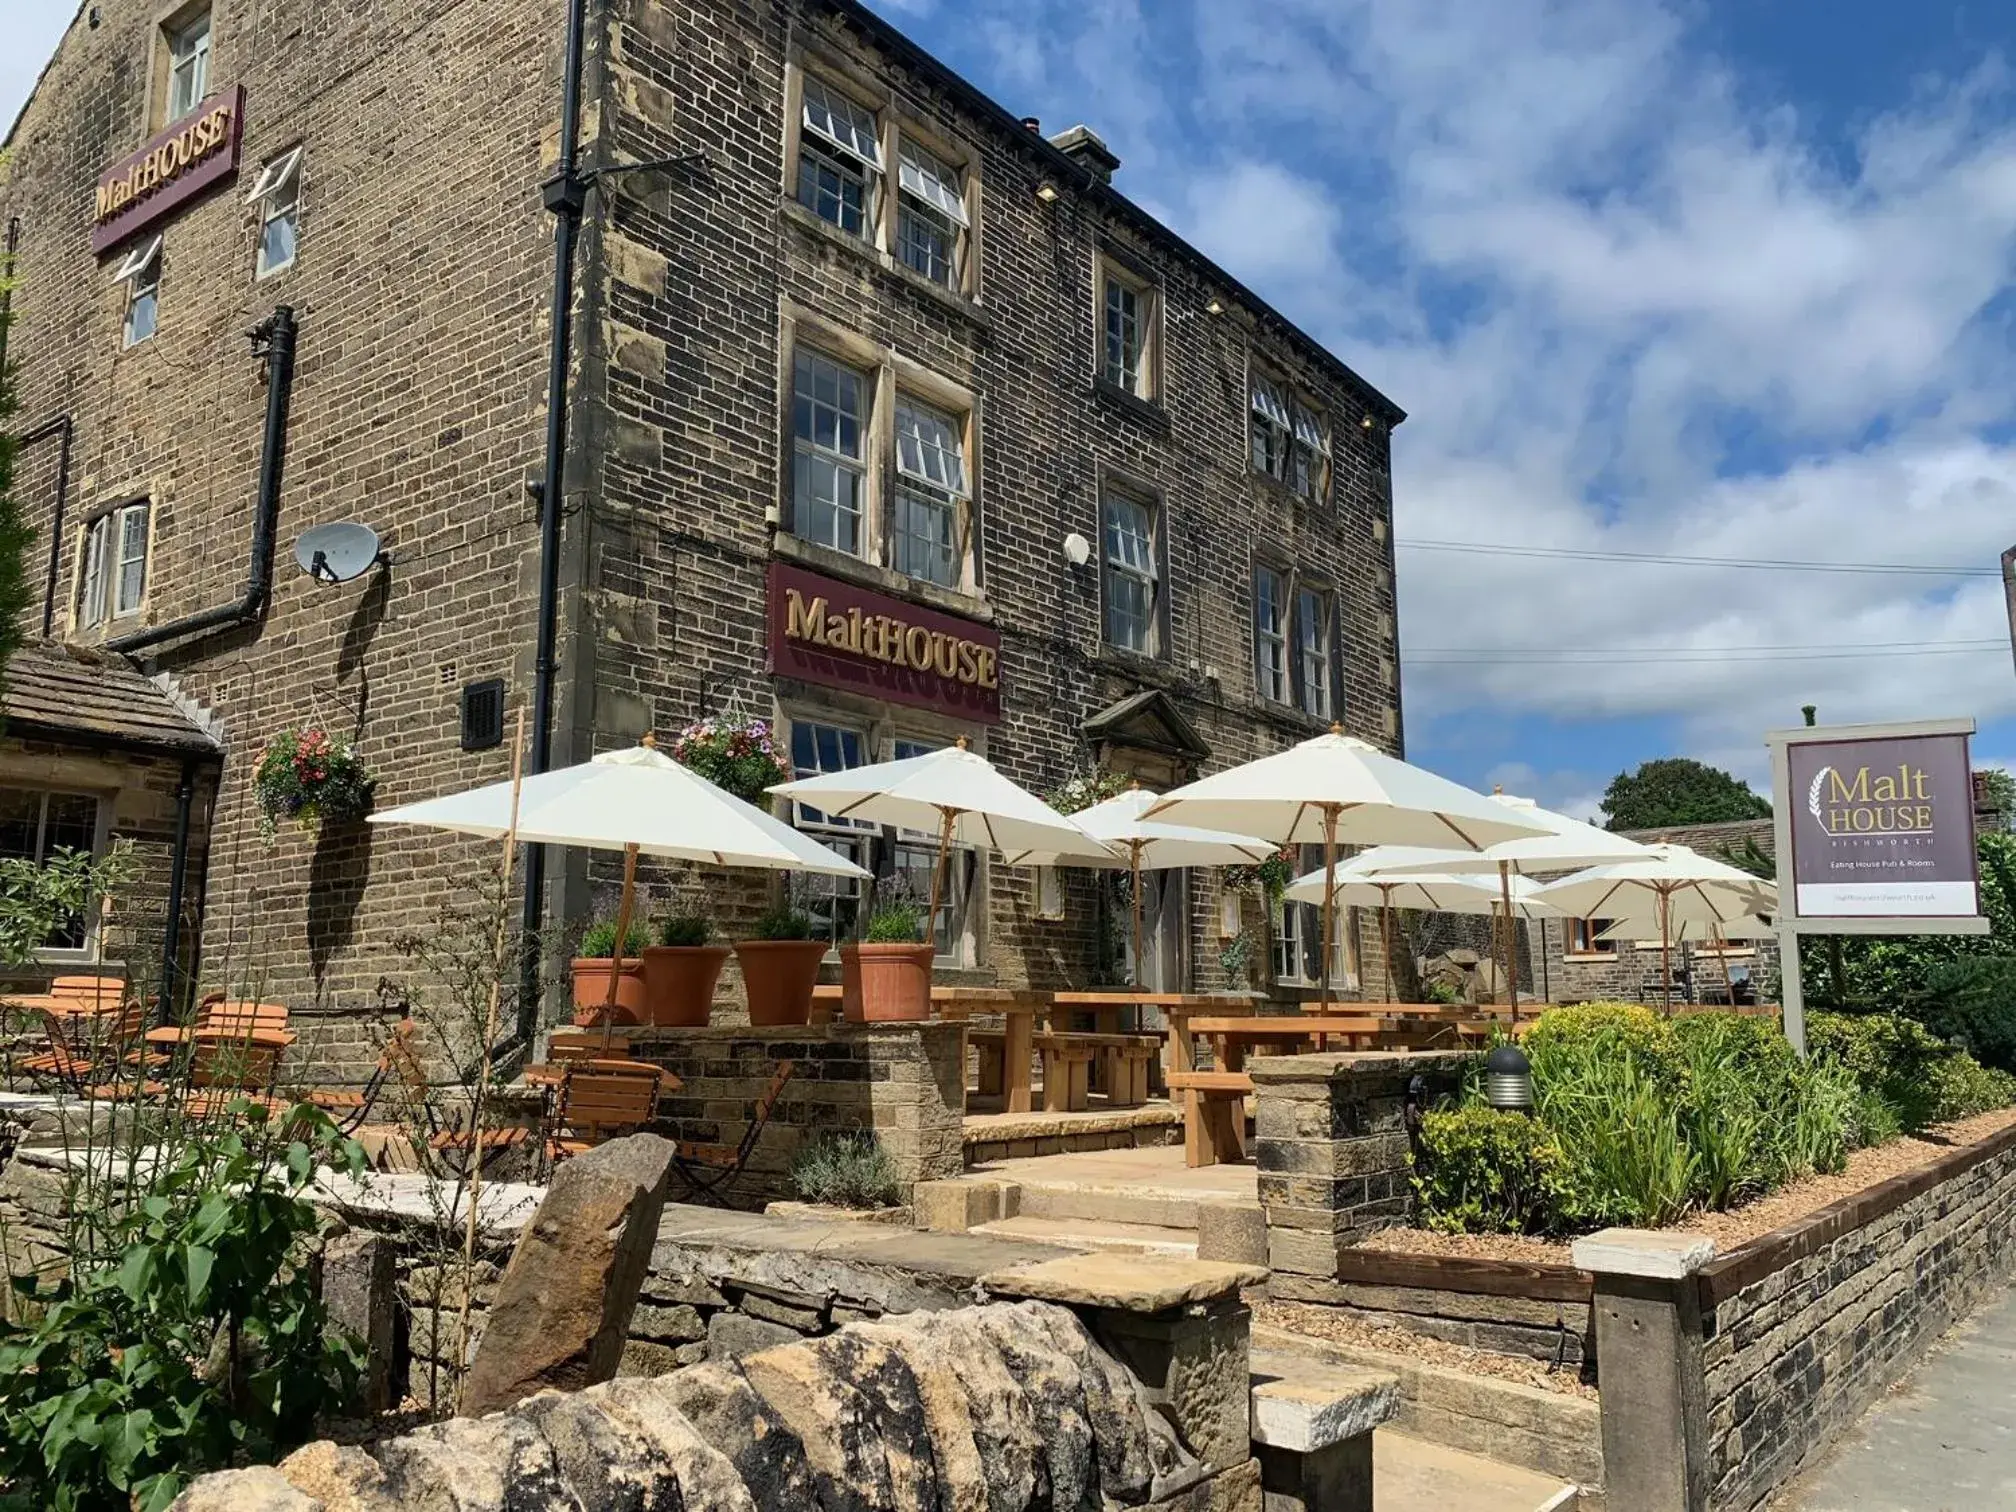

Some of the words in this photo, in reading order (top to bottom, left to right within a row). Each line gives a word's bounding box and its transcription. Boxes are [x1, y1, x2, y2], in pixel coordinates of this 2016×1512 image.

[785, 587, 999, 690] MaltHOUSE
[1828, 763, 1932, 804] Malt
[1828, 805, 1935, 832] HOUSE
[1830, 837, 1935, 848] RISHWORTH
[1830, 860, 1855, 870] Eating
[1855, 860, 1881, 869] House
[1882, 860, 1898, 868] Pub
[1899, 859, 1906, 867] &
[1907, 859, 1936, 868] Rooms
